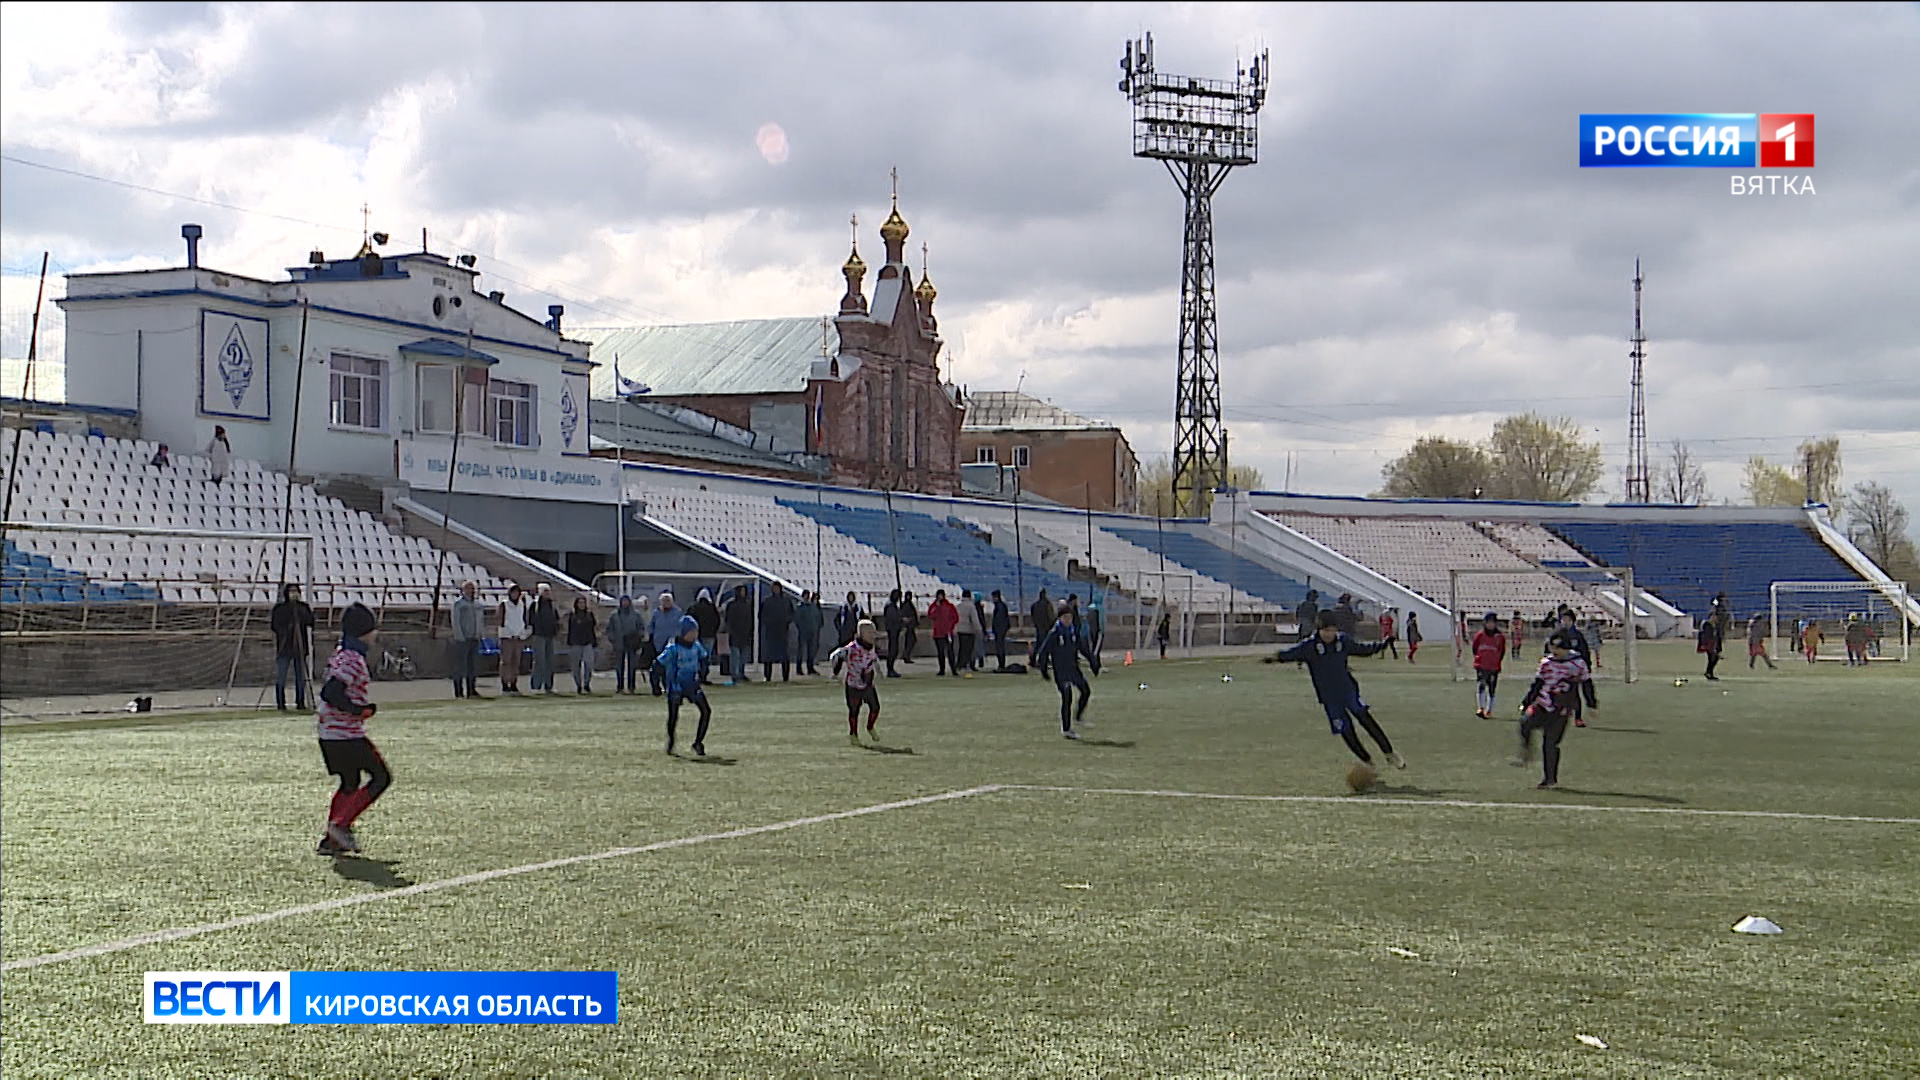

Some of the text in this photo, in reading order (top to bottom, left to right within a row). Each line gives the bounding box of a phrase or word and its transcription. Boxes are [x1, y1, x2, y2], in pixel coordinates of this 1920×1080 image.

[427, 459, 448, 472] МЫ
[451, 461, 493, 478] ОРДЫ,
[496, 465, 517, 479] ЧТО
[519, 468, 537, 480] МЫ
